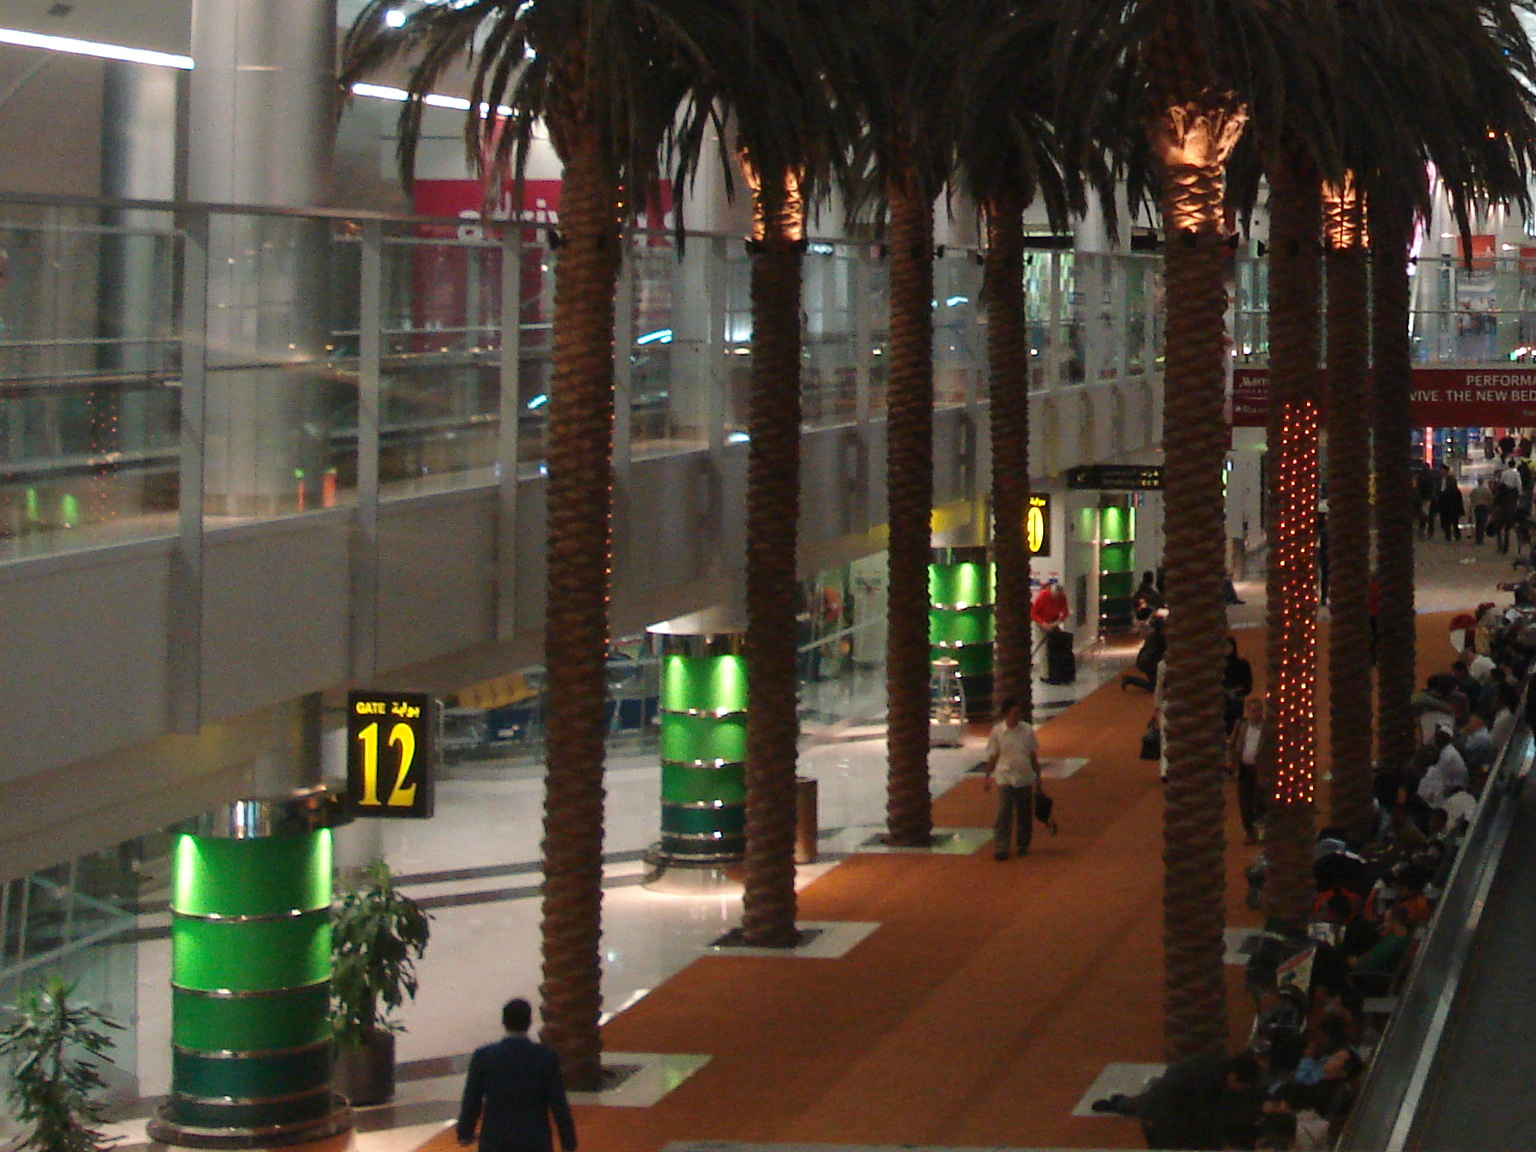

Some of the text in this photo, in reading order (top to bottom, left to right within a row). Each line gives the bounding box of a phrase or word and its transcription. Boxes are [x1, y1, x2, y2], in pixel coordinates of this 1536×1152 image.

[1446, 390, 1472, 402] THE
[1476, 390, 1508, 402] NEW
[356, 701, 387, 715] GATE
[357, 721, 417, 807] 12
